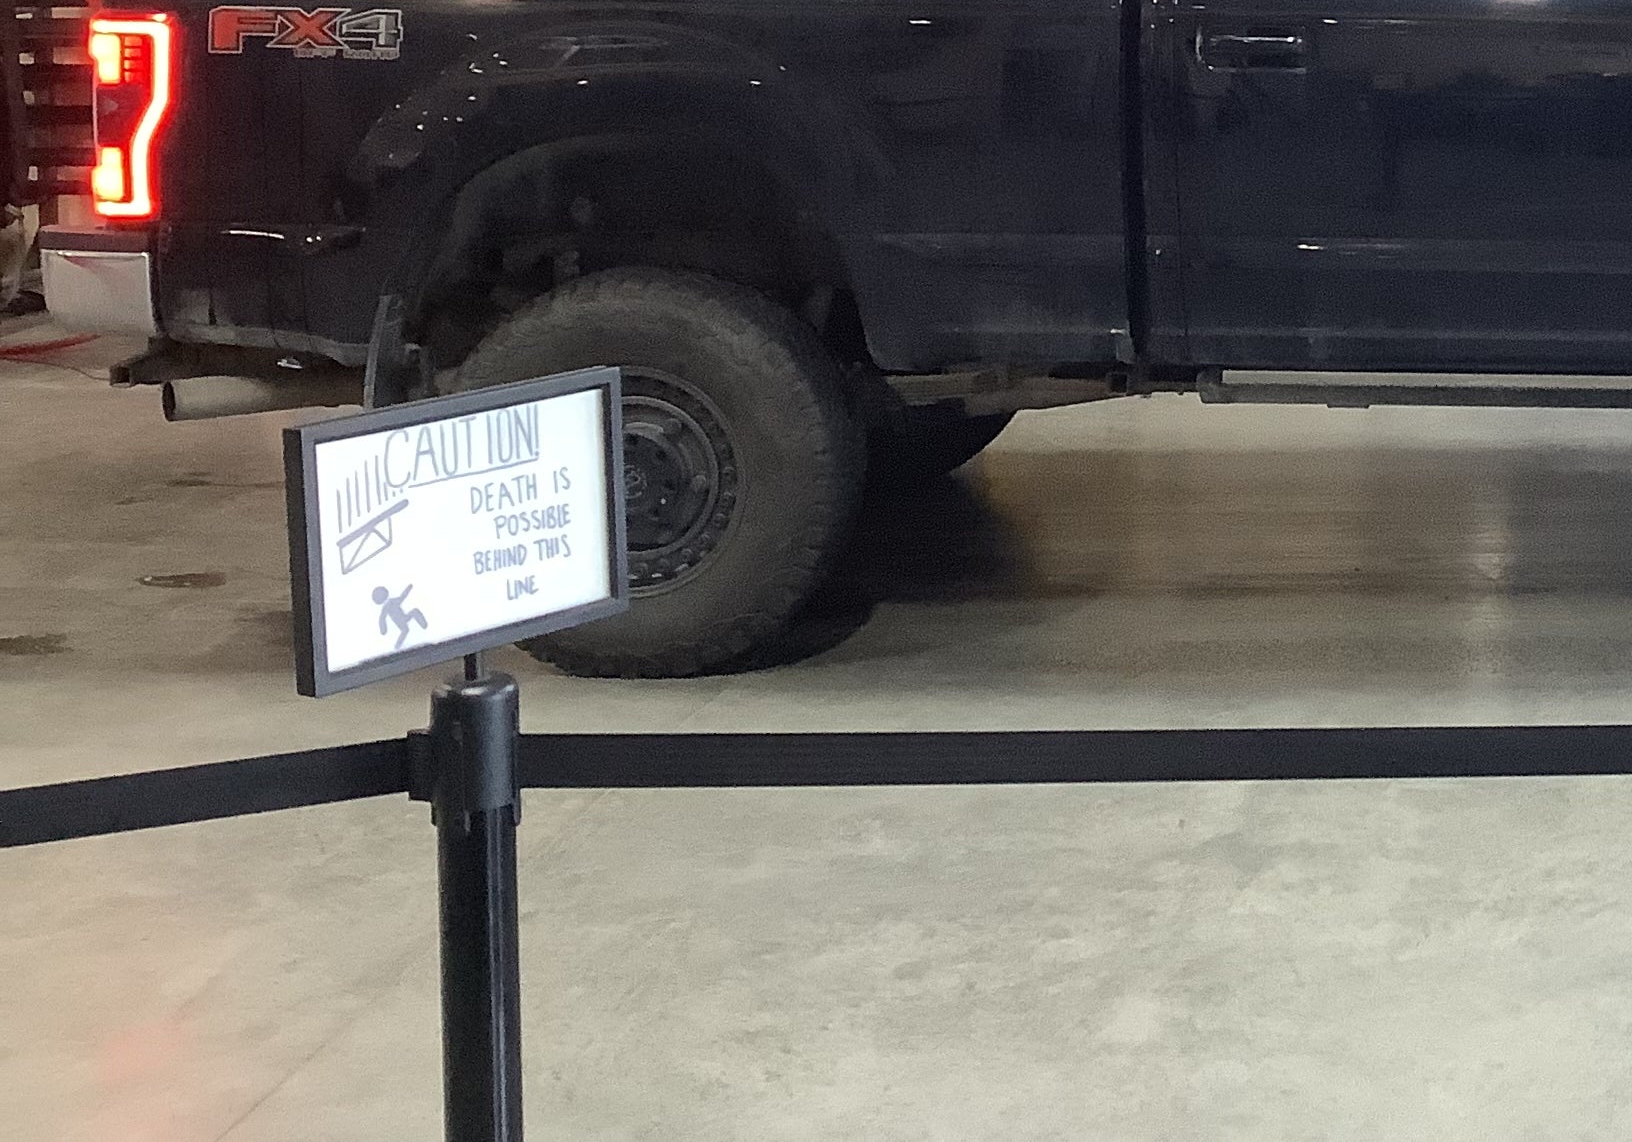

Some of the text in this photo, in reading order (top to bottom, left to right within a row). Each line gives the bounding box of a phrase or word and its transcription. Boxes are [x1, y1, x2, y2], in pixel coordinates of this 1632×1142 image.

[208, 5, 403, 54] FX4
[384, 404, 540, 488] CAUTION!
[470, 466, 571, 514] DEATH IS
[494, 503, 571, 539] POSSIBLE
[473, 534, 572, 575] BEHIND THIS
[506, 575, 540, 601] LINE
